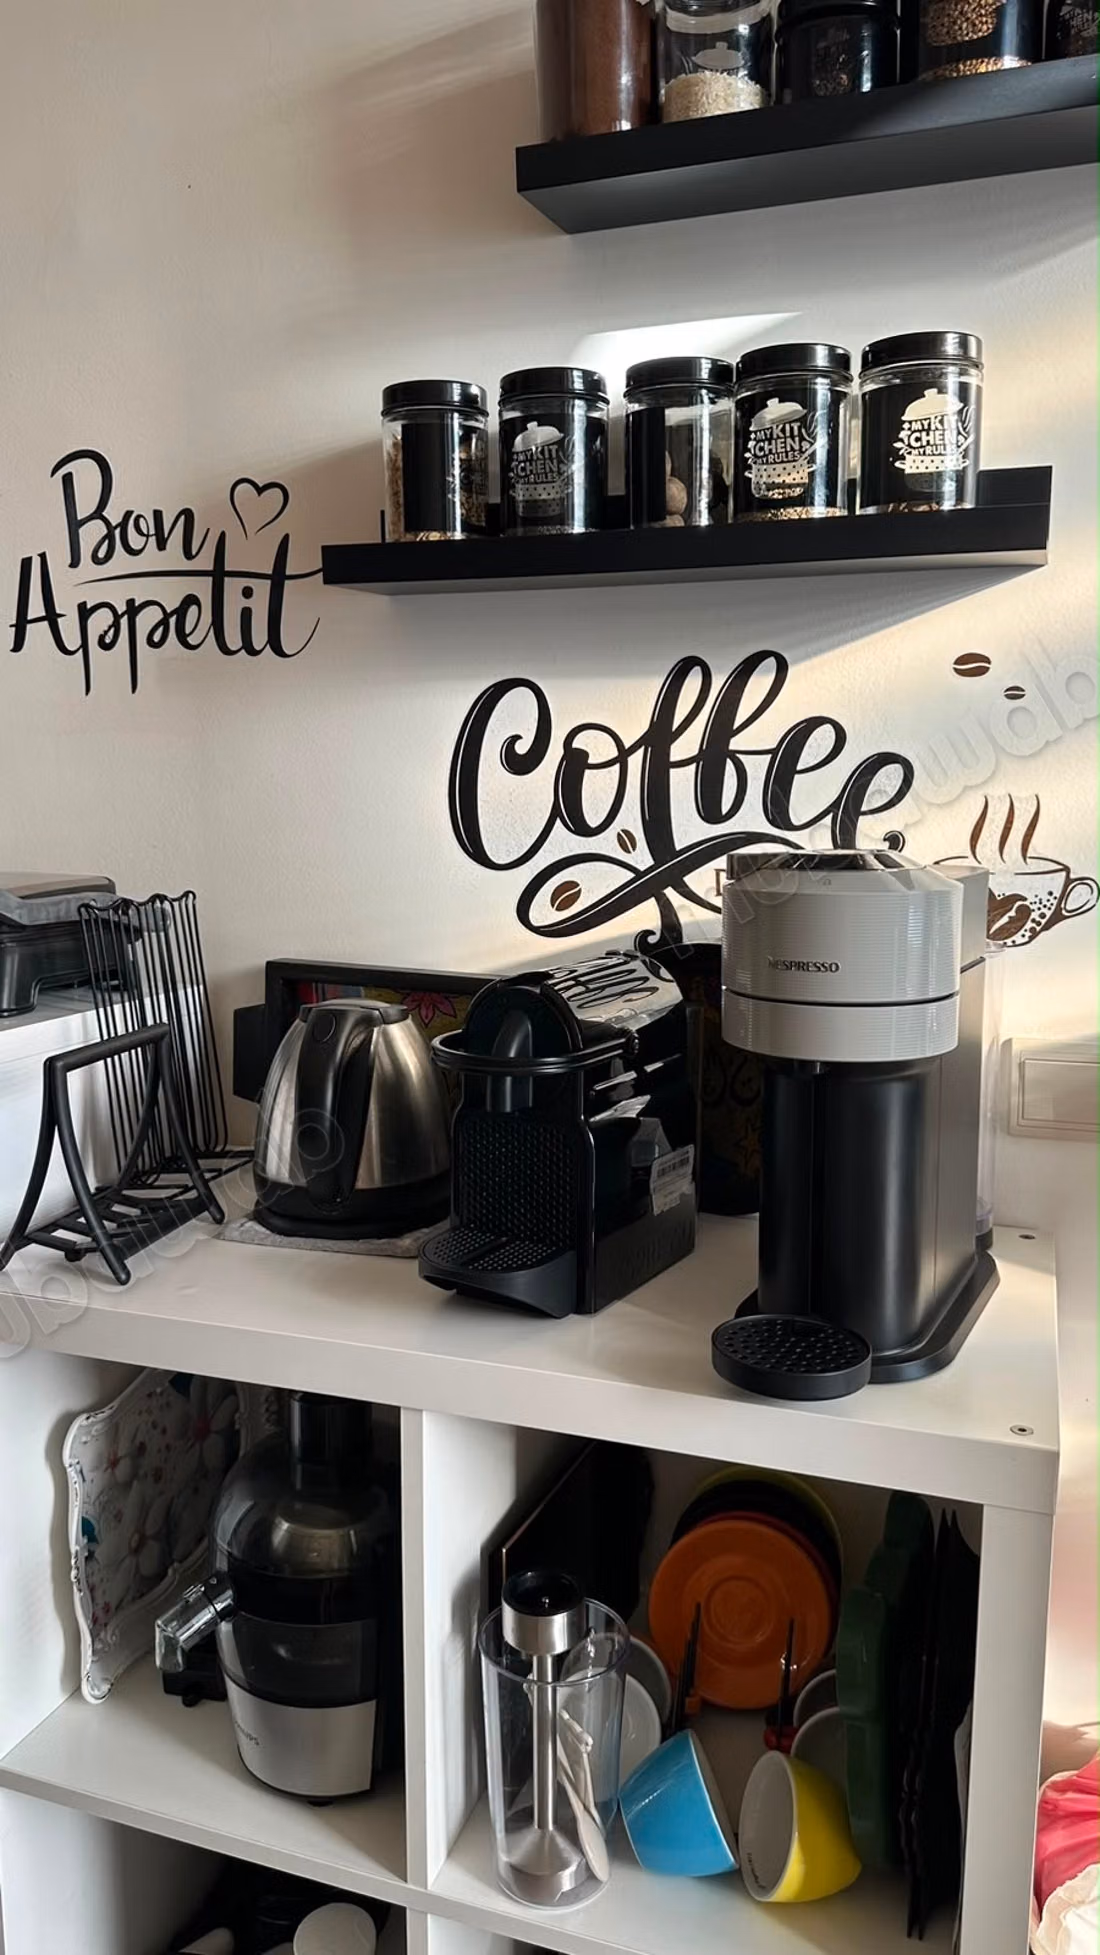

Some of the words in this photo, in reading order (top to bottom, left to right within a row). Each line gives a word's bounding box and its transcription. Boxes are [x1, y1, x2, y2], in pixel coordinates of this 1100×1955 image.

[756, 428, 772, 441] MY
[772, 422, 802, 440] KIT
[930, 415, 958, 440] KIT
[754, 437, 800, 456] CHEN
[909, 431, 958, 448] CHEN
[532, 445, 559, 460] KIT
[767, 451, 801, 464] RULES
[517, 459, 558, 477] CHEN
[528, 472, 559, 484] RULES
[50, 448, 211, 569] Bon
[9, 530, 322, 696] Appetit
[448, 649, 916, 948] Coffee
[767, 957, 841, 973] NESPRESSO
